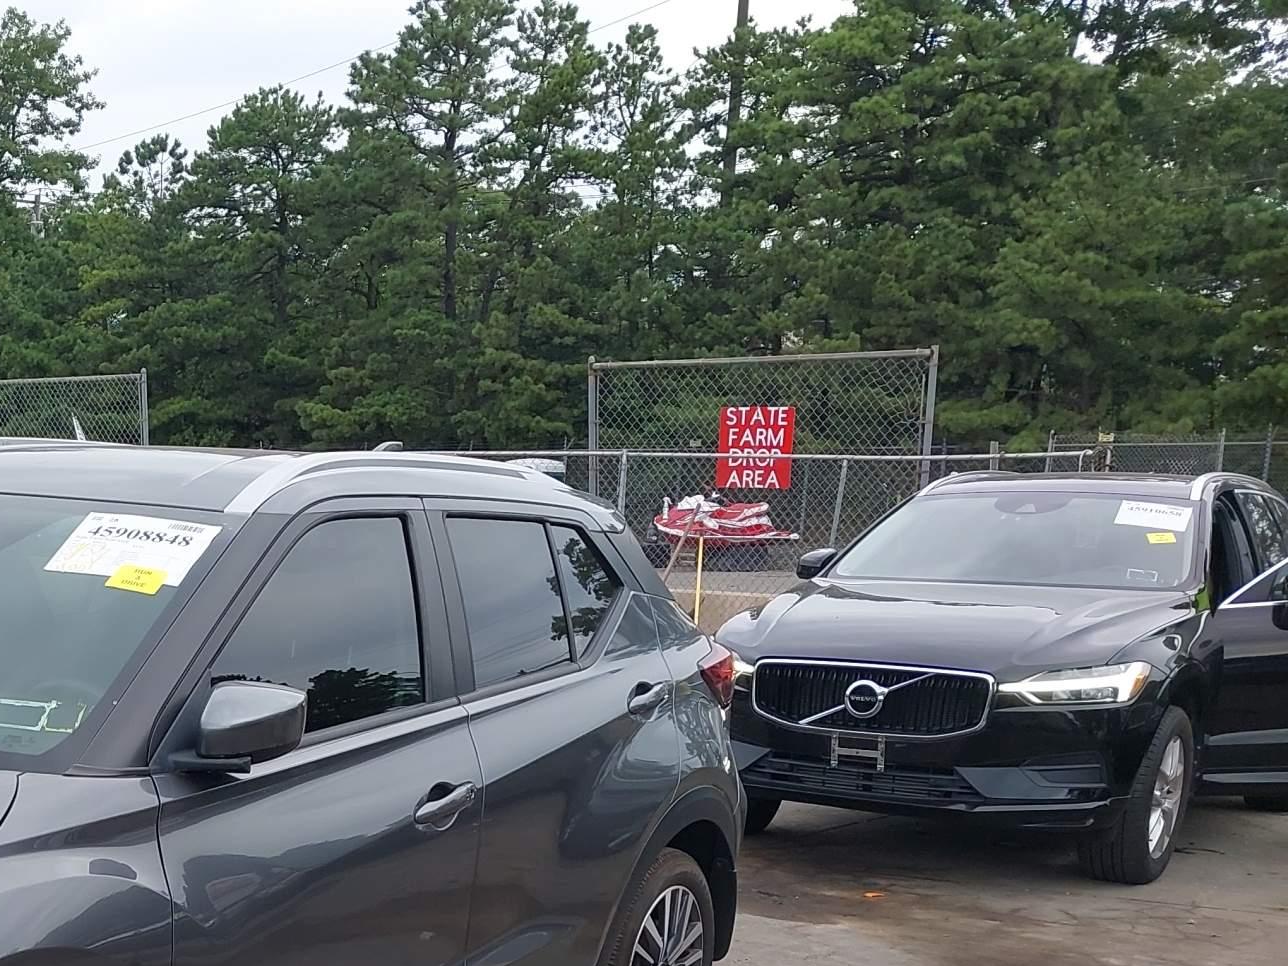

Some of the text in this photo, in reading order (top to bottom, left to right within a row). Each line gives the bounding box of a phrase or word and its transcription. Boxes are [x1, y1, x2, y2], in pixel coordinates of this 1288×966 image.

[726, 407, 788, 426] STATE
[728, 428, 785, 447] FARM
[728, 448, 782, 467] DROP
[726, 470, 780, 489] AREA
[87, 525, 194, 548] 45908848
